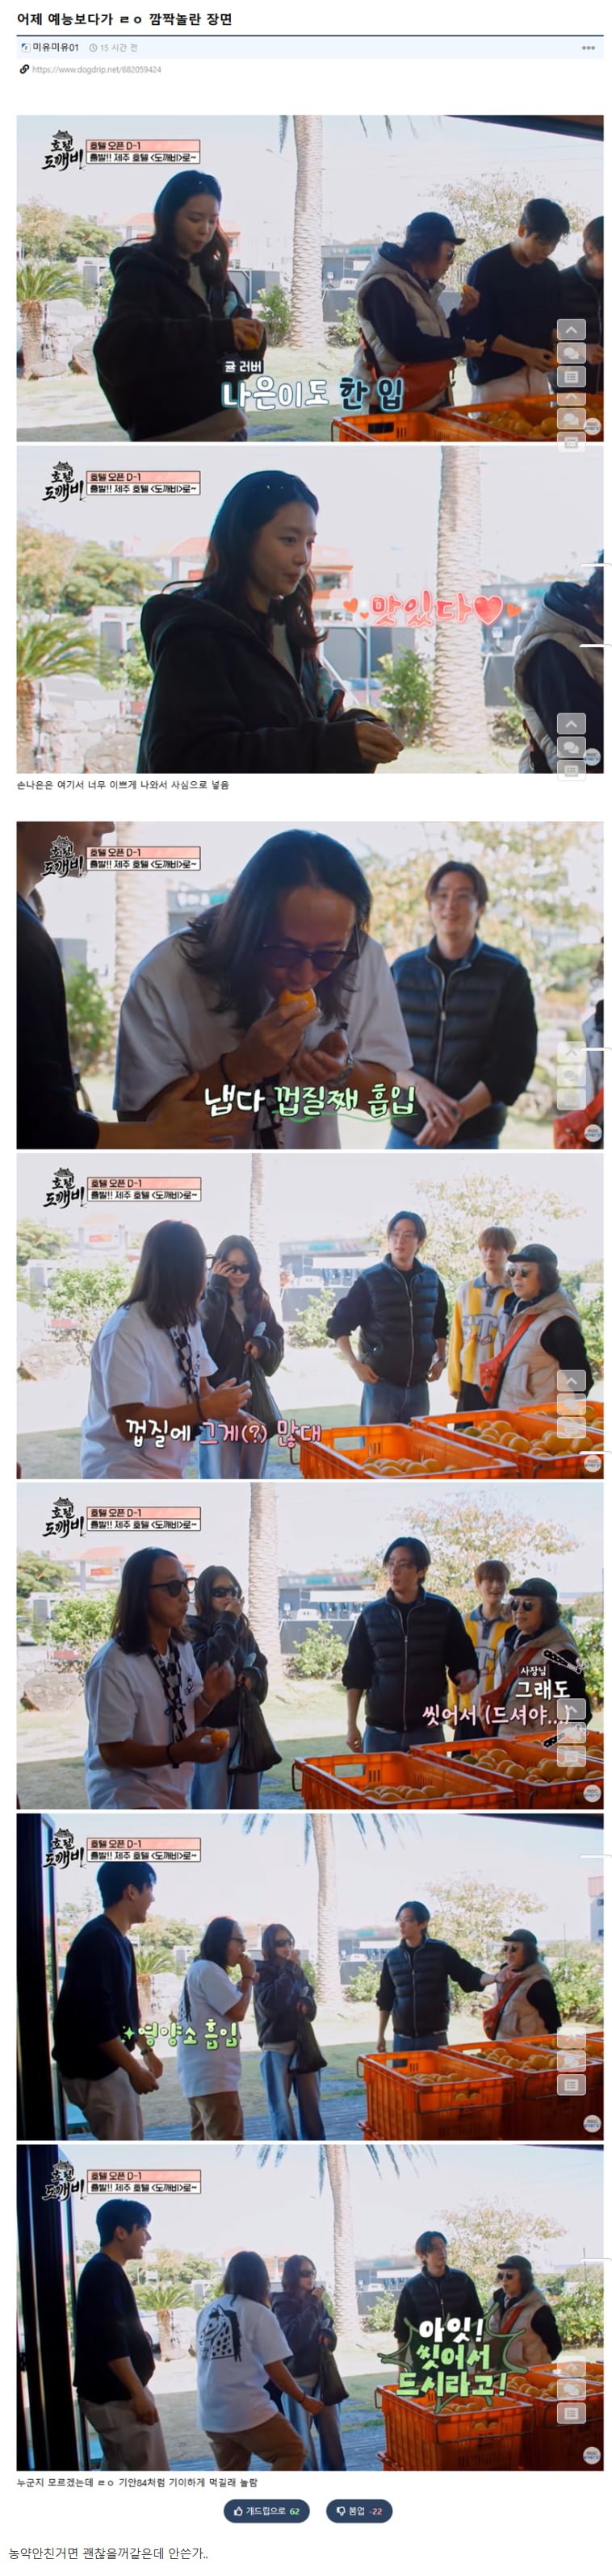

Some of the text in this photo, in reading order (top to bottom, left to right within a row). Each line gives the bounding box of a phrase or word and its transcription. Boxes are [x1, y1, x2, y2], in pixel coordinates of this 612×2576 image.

[18, 13, 42, 26] 어제
[48, 13, 113, 26] 예능보다가
[149, 13, 202, 26] 깜짝놀란
[207, 13, 232, 26] 장면
[32, 43, 79, 52] 미유미유01
[100, 44, 138, 52] 15 시간 전
[32, 65, 161, 74] https://www.dogdrip.net/682059424
[17, 780, 229, 790] 손나은은 여기서 너무 이쁘게 나와서 사심으로 넣음
[17, 2478, 44, 2488] 누군지
[48, 2478, 94, 2488] 모르겠는데
[119, 2478, 166, 2488] 기안84처럼
[170, 2478, 205, 2488] 기이하게
[210, 2478, 237, 2488] 먹길래
[240, 2478, 258, 2488] 놀람
[246, 2507, 300, 2515] 개드립으로 62
[349, 2507, 383, 2515] 붐업 -22
[8, 2548, 208, 2560] 농약안친거면 괜찮을꺼같은데 안쓴가..
